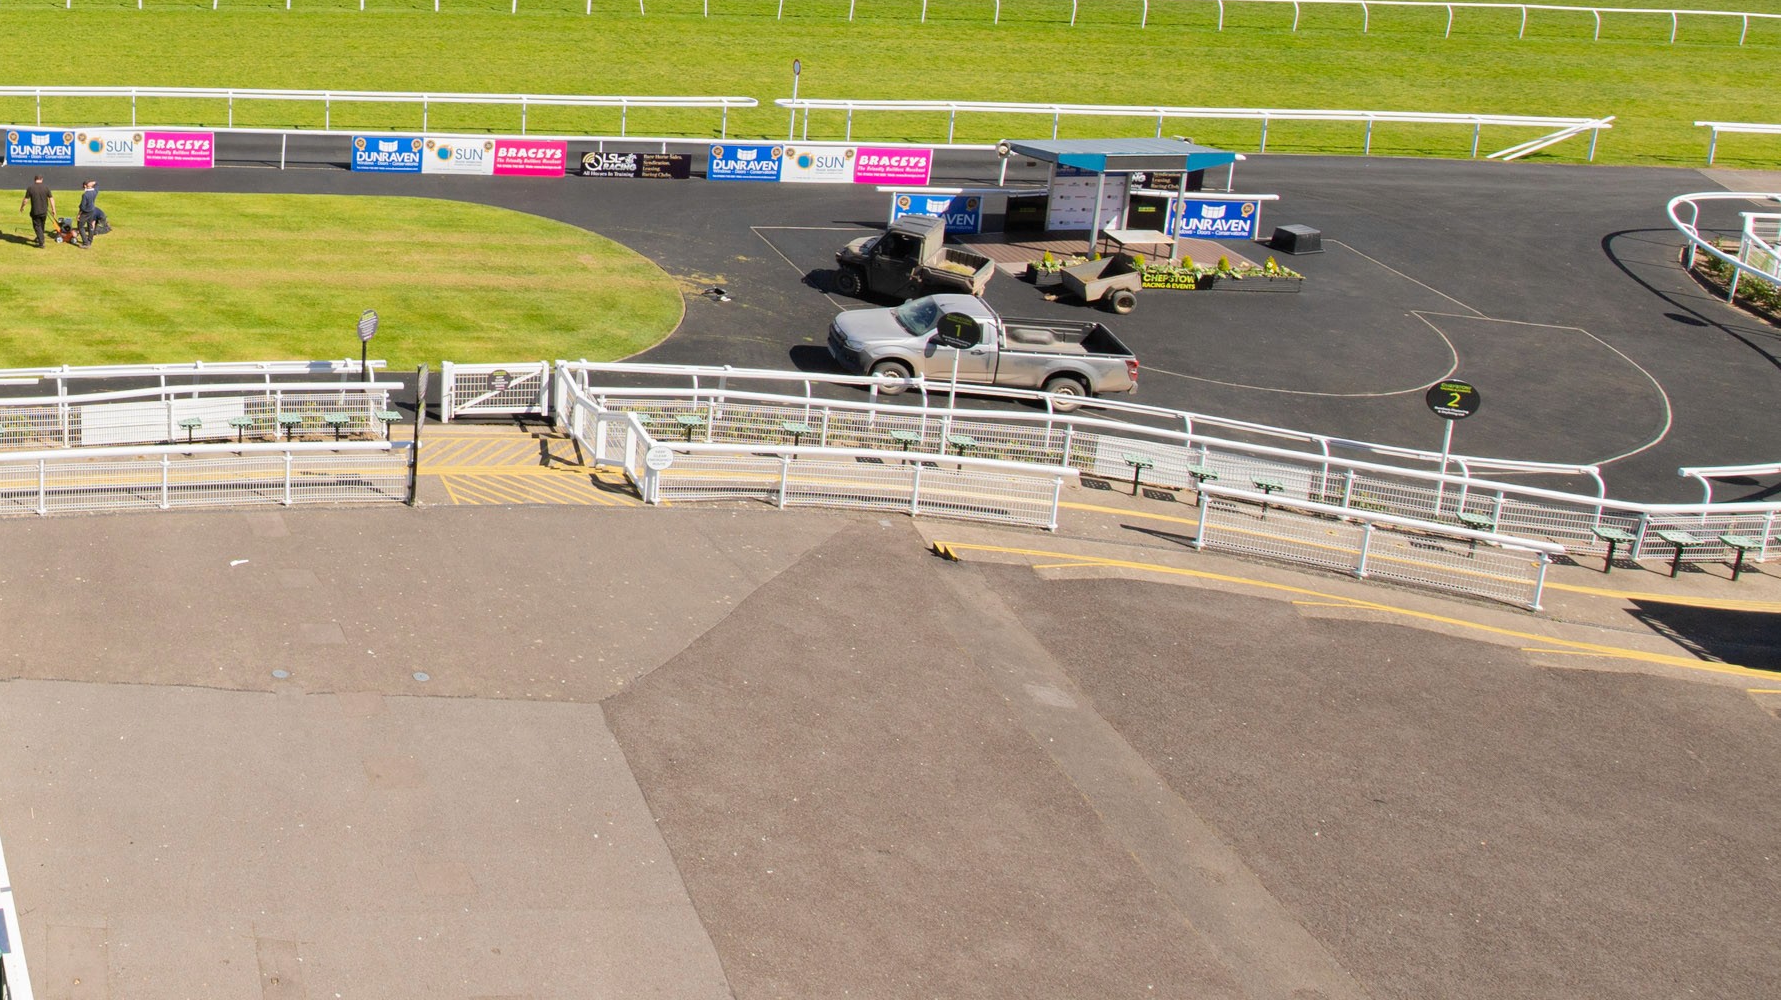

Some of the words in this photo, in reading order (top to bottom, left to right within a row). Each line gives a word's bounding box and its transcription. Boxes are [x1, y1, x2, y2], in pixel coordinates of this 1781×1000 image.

[10, 145, 71, 155] DUNRAVEN
[106, 140, 133, 152] SUN
[147, 139, 210, 150] BRACEYS
[357, 151, 419, 162] DUNRAVEN
[455, 148, 482, 160] SUN
[498, 147, 562, 159] BRACEYS
[603, 153, 619, 163] LSL
[603, 163, 636, 171] RACING
[713, 159, 778, 171] DUNRAVEN
[816, 156, 844, 168] SUN
[859, 155, 926, 167] BRACEYS
[1143, 274, 1195, 283] CHEPSTOW
[955, 324, 961, 337] 1
[1447, 392, 1461, 407] 2
